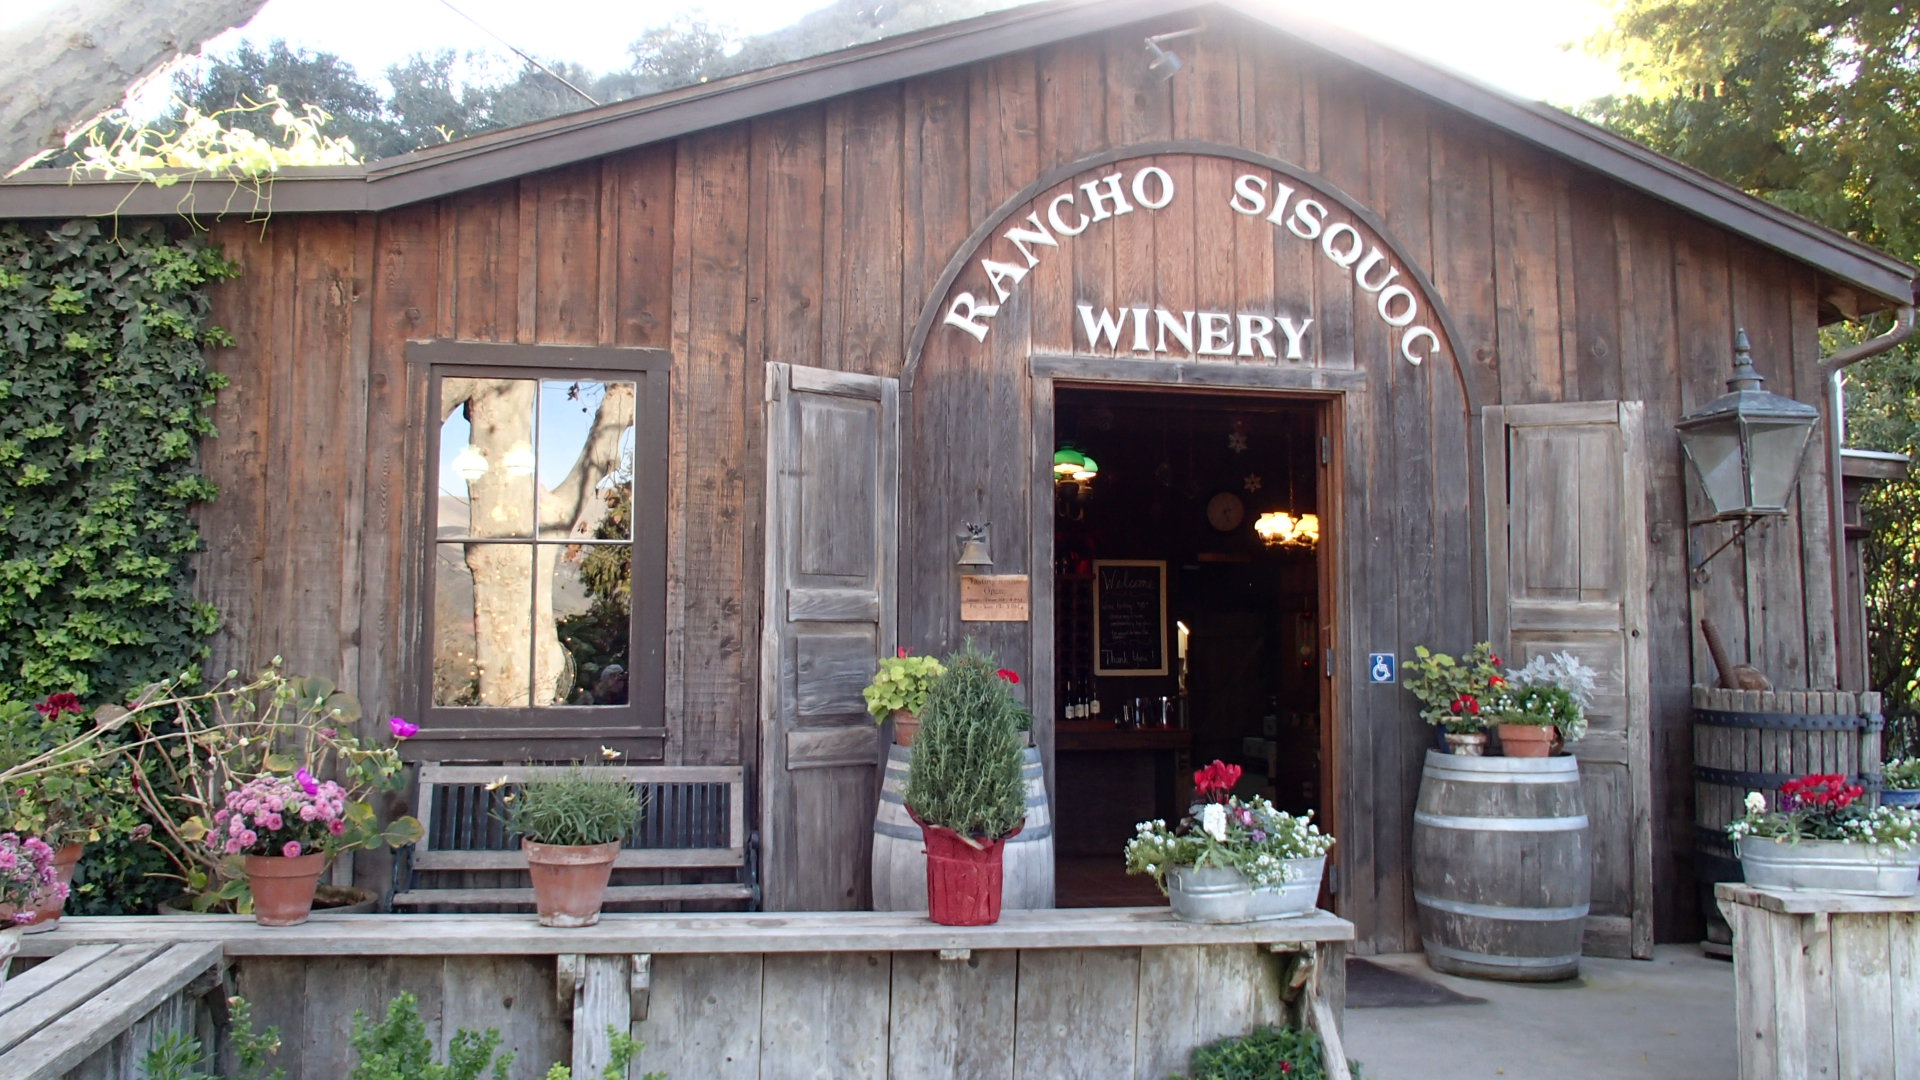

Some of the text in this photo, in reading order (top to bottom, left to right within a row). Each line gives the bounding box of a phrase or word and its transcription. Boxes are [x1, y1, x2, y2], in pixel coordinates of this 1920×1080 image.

[944, 165, 1441, 366] RANCHO SISQUOC
[1077, 304, 1315, 360] WINERY
